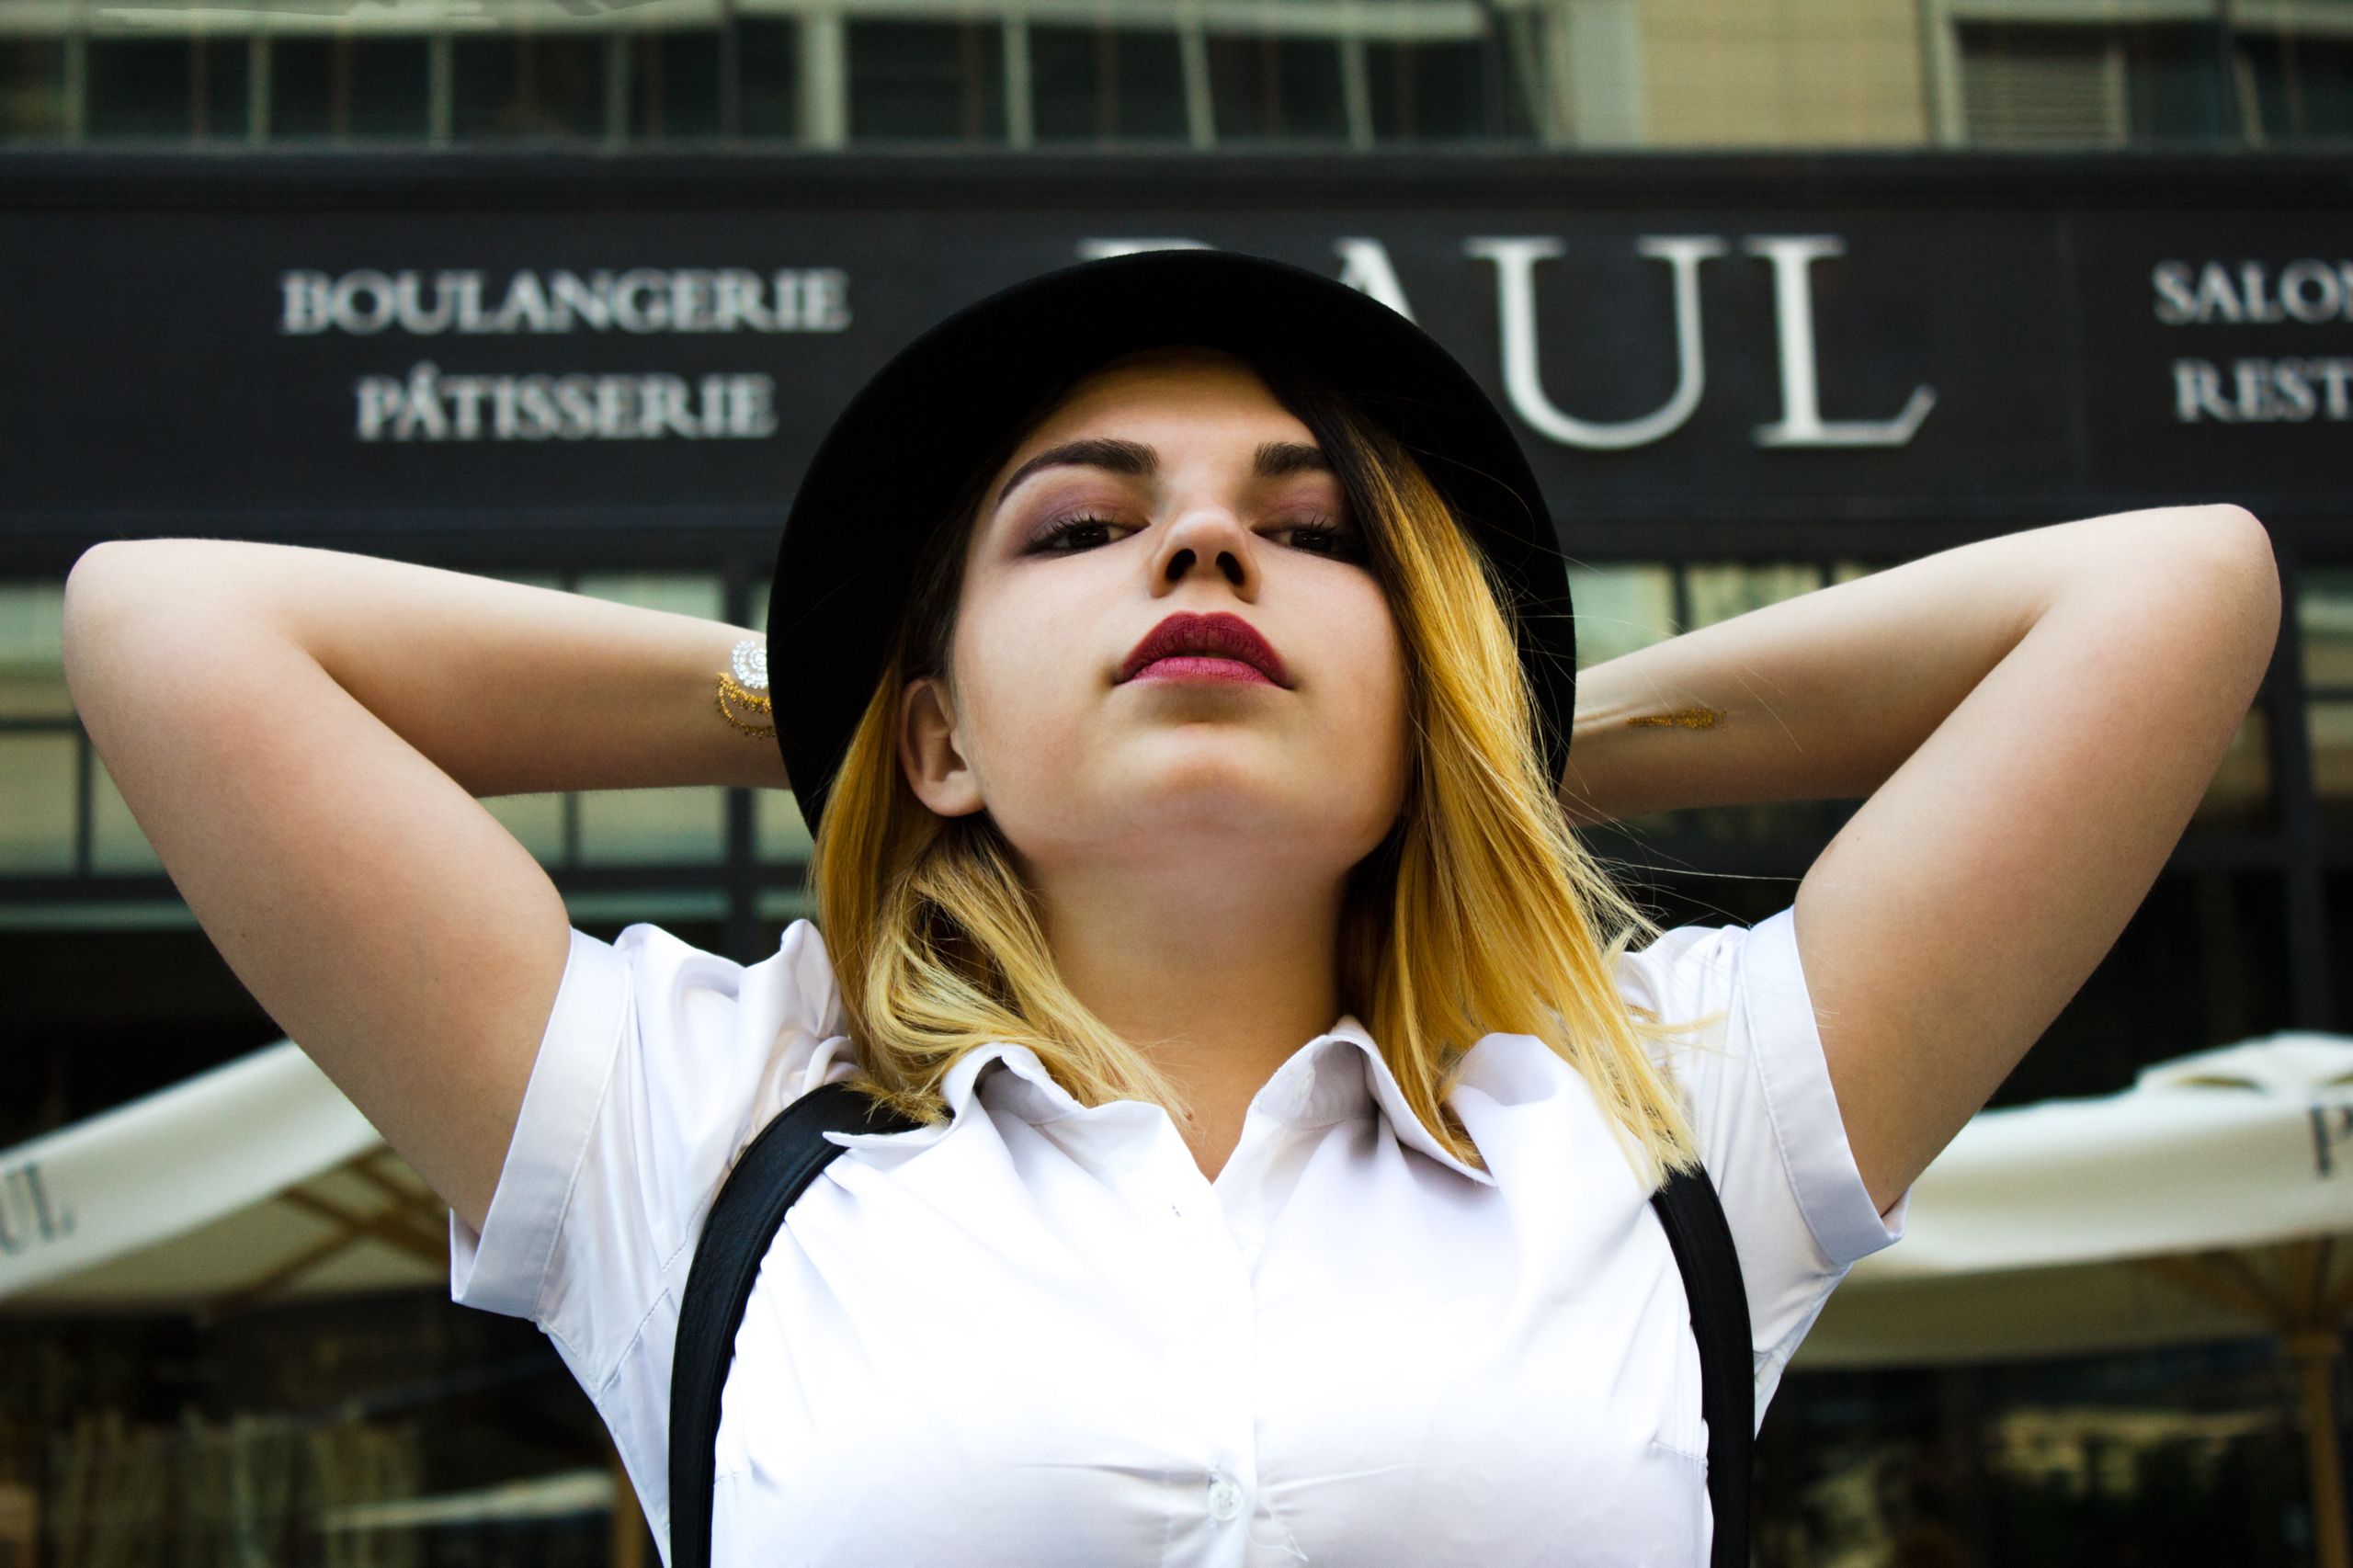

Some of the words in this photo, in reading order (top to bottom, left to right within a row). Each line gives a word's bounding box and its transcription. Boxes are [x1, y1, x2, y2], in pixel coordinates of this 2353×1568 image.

[281, 269, 851, 335] BOULANGERIE
[2153, 258, 2353, 324] SALO
[1078, 235, 1938, 449] UL
[357, 361, 778, 440] PÂTISSERIE
[2174, 358, 2353, 423] REST
